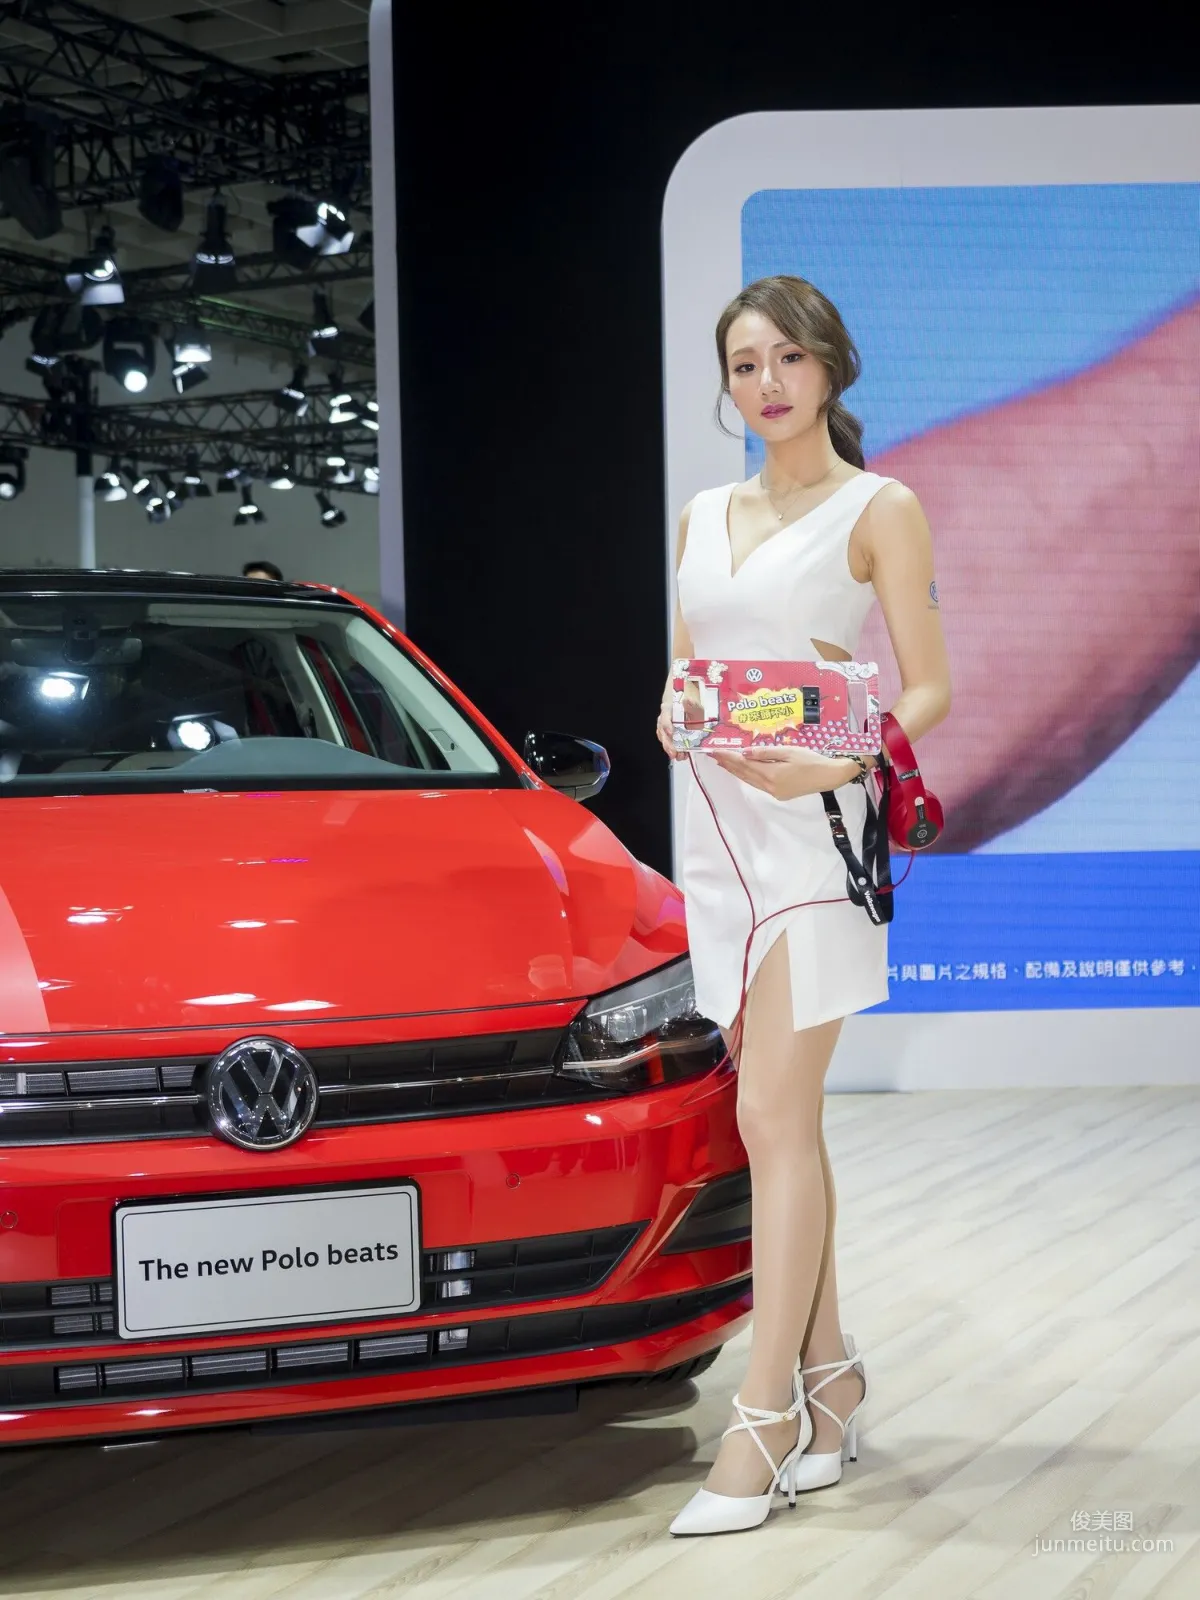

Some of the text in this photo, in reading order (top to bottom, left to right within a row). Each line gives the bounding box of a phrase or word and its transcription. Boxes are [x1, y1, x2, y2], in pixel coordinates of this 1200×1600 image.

[727, 693, 797, 712] Polo beats
[708, 737, 744, 745] ASUS
[138, 1242, 399, 1282] The new Polo beats
